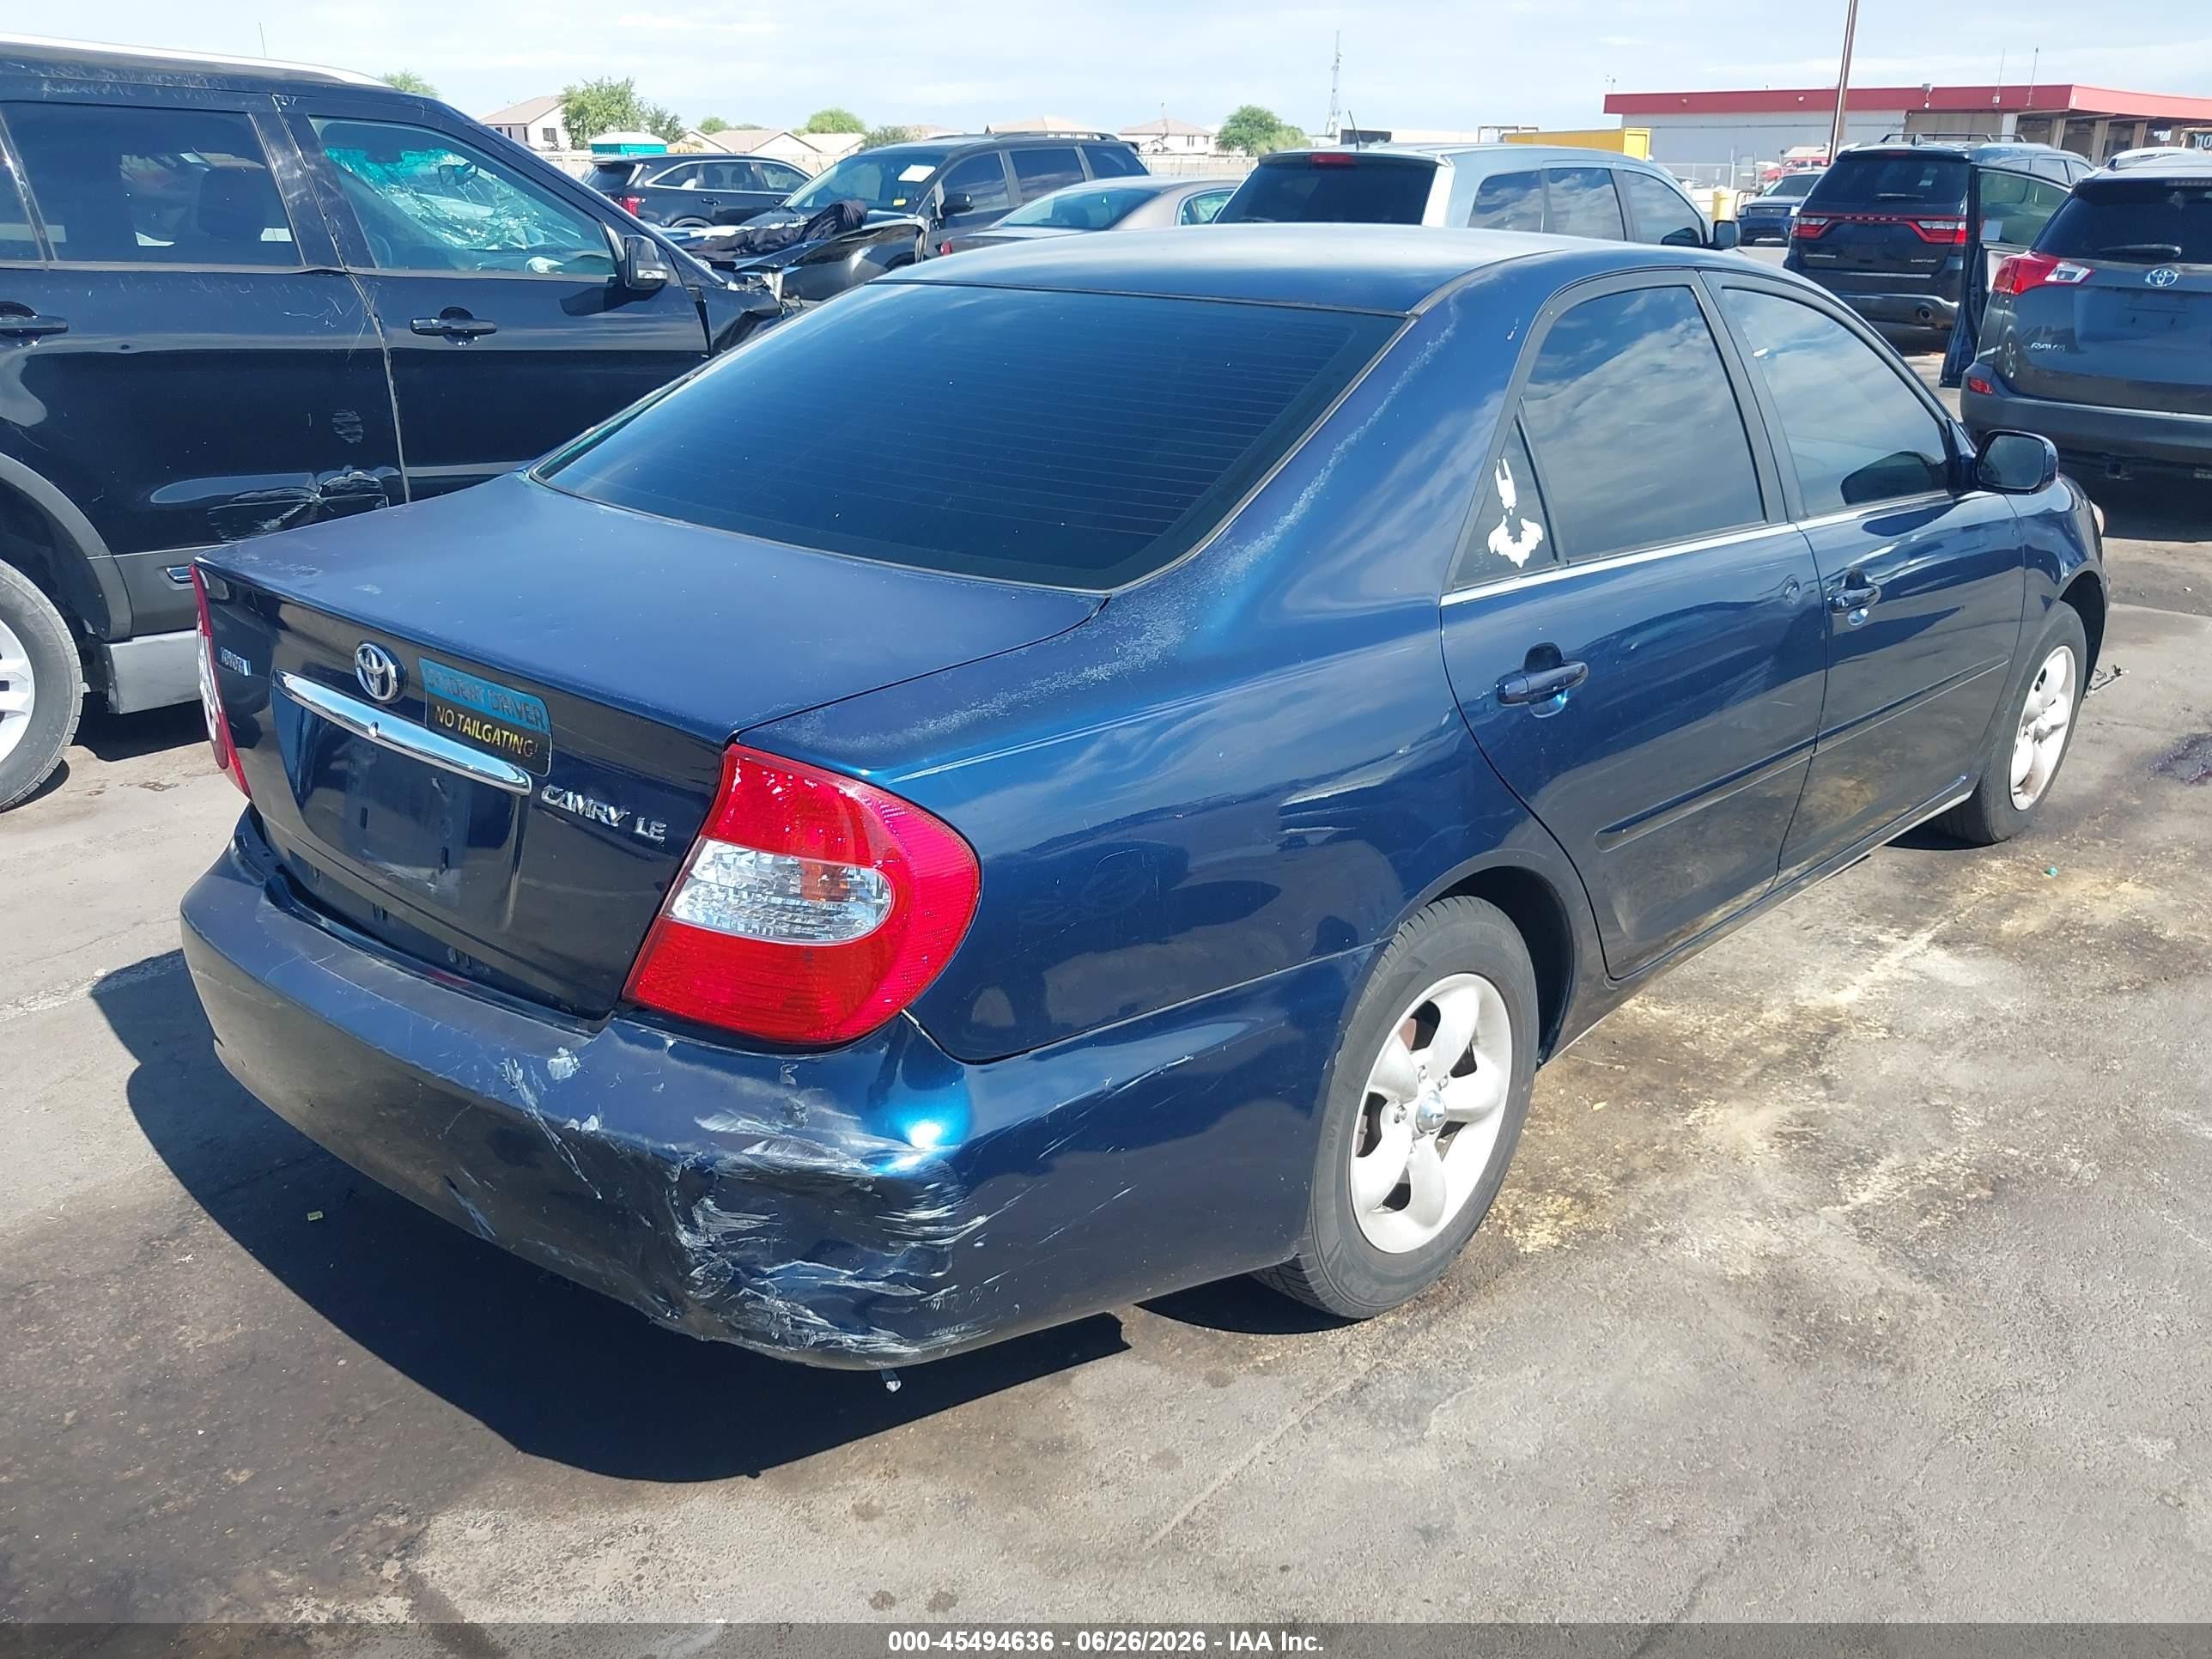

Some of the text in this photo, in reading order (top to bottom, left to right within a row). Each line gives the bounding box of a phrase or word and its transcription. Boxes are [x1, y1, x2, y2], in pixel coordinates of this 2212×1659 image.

[434, 705, 455, 727] NO
[488, 690, 547, 730] DRIVER
[541, 784, 666, 845] CAMRY LE
